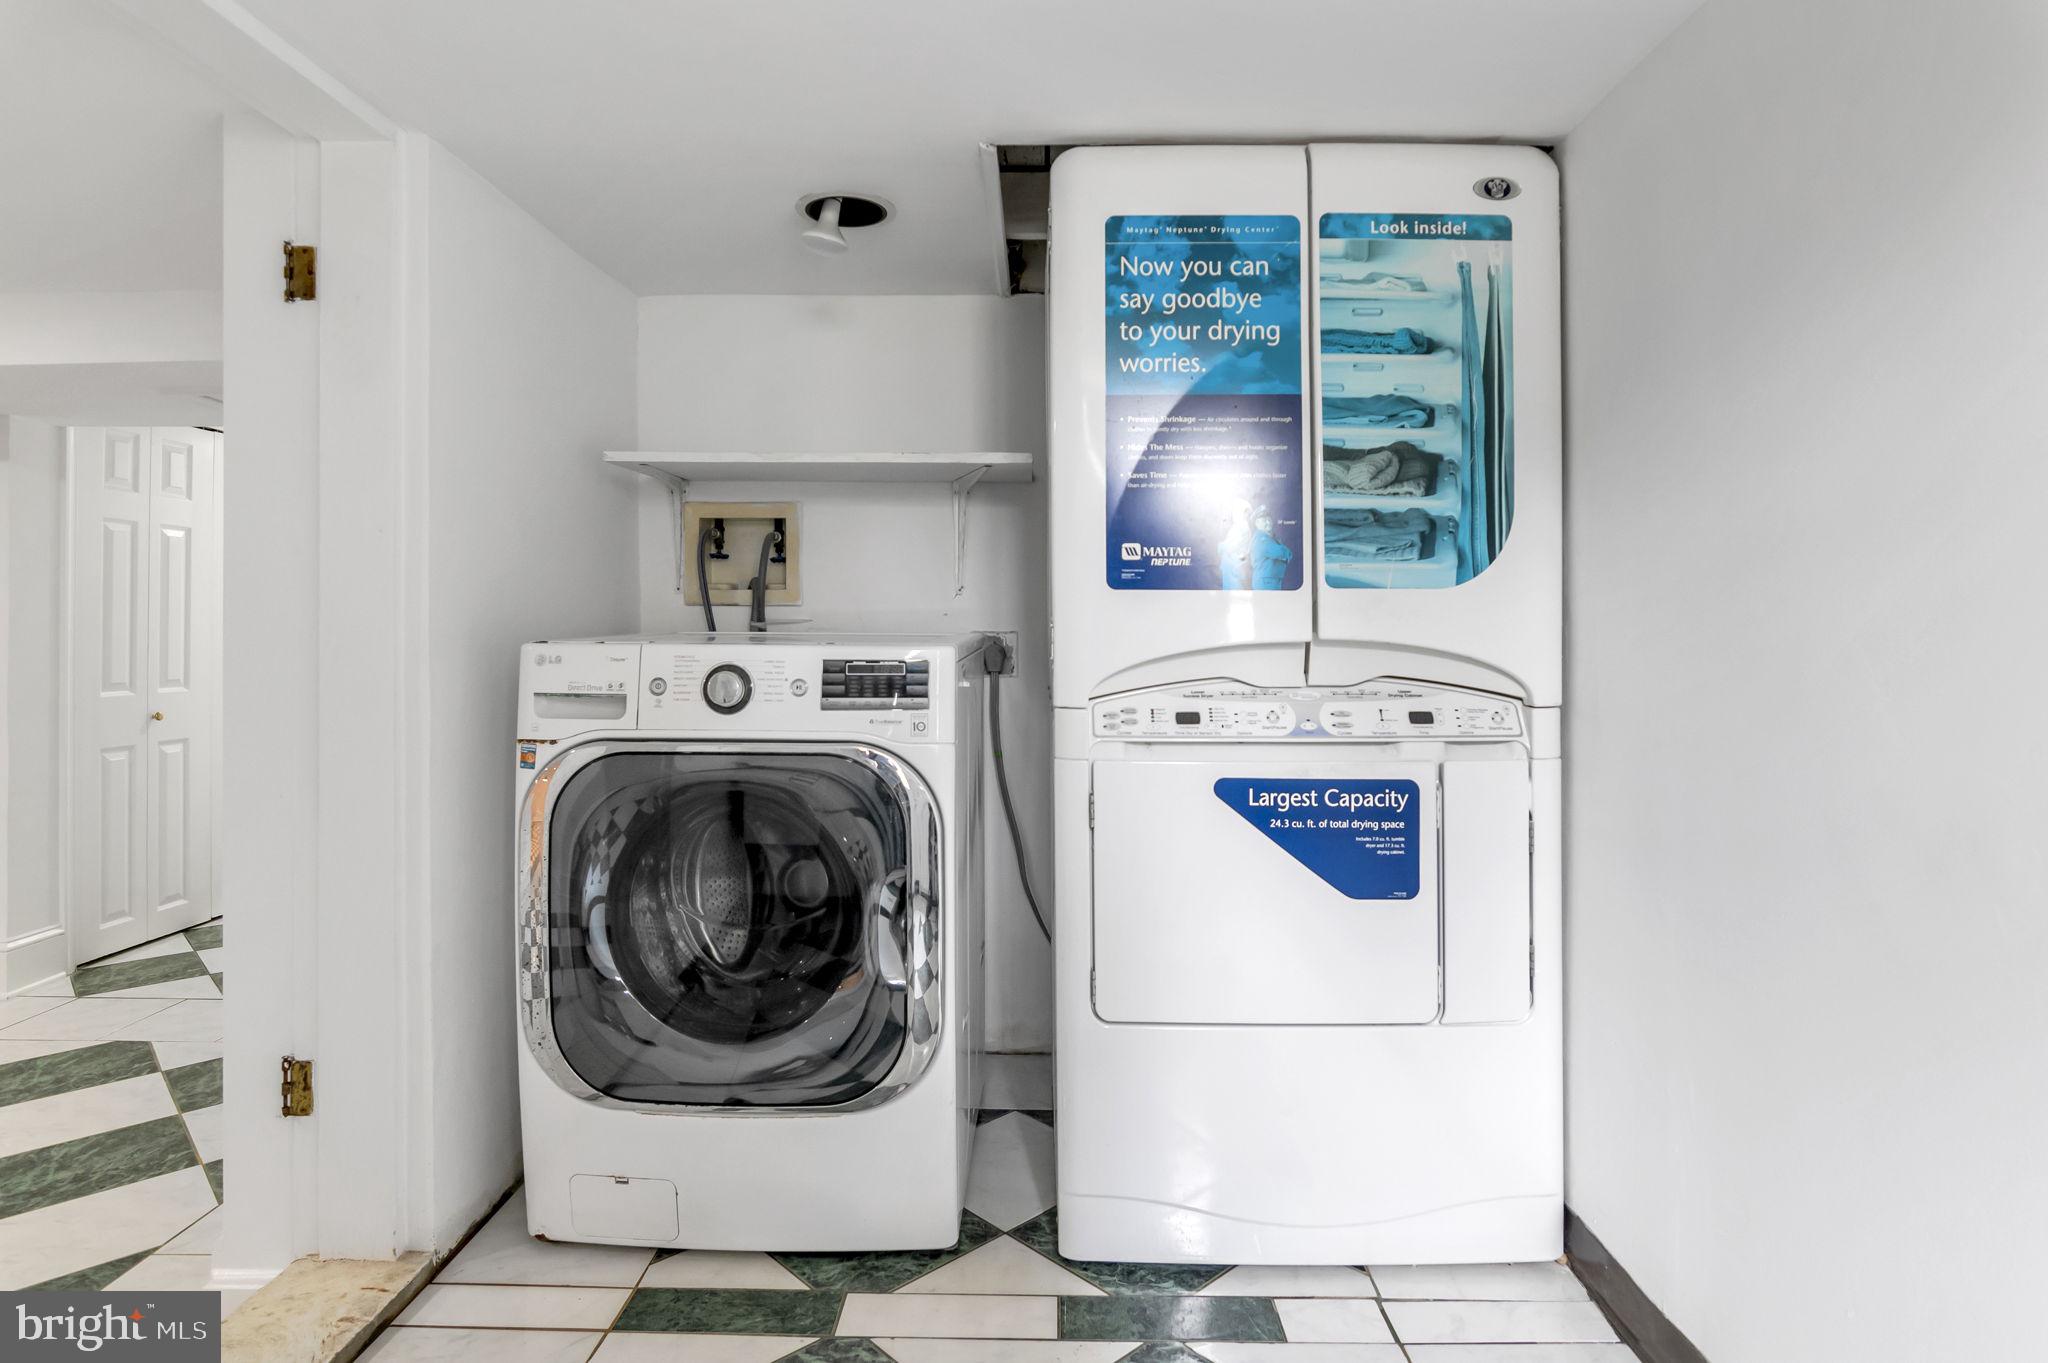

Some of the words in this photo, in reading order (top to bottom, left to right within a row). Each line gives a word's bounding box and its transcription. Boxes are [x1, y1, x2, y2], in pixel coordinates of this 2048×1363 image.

[1211, 226, 1241, 234] Drying
[1371, 221, 1408, 234] Look
[1414, 221, 1467, 235] inside!
[1120, 256, 1174, 276] Now
[1180, 260, 1221, 282] you
[1230, 260, 1269, 276] can
[1119, 292, 1154, 315] say
[1162, 287, 1262, 315] goodbye
[1119, 322, 1143, 341] to
[1150, 324, 1201, 347] your
[1208, 319, 1281, 346] drying
[1119, 352, 1207, 373] worries.
[1160, 415, 1196, 424] Shrinkage
[1271, 416, 1292, 424] through
[1143, 546, 1192, 557] MAYTAG
[548, 655, 562, 664] LG
[1249, 788, 1318, 812] Largest
[1324, 788, 1409, 812] Capacity
[1270, 819, 1289, 828] 24.3
[1307, 819, 1317, 828] ft.
[1319, 819, 1328, 828] of
[1330, 819, 1349, 828] total
[1351, 819, 1378, 831] drying
[1380, 821, 1405, 830] space
